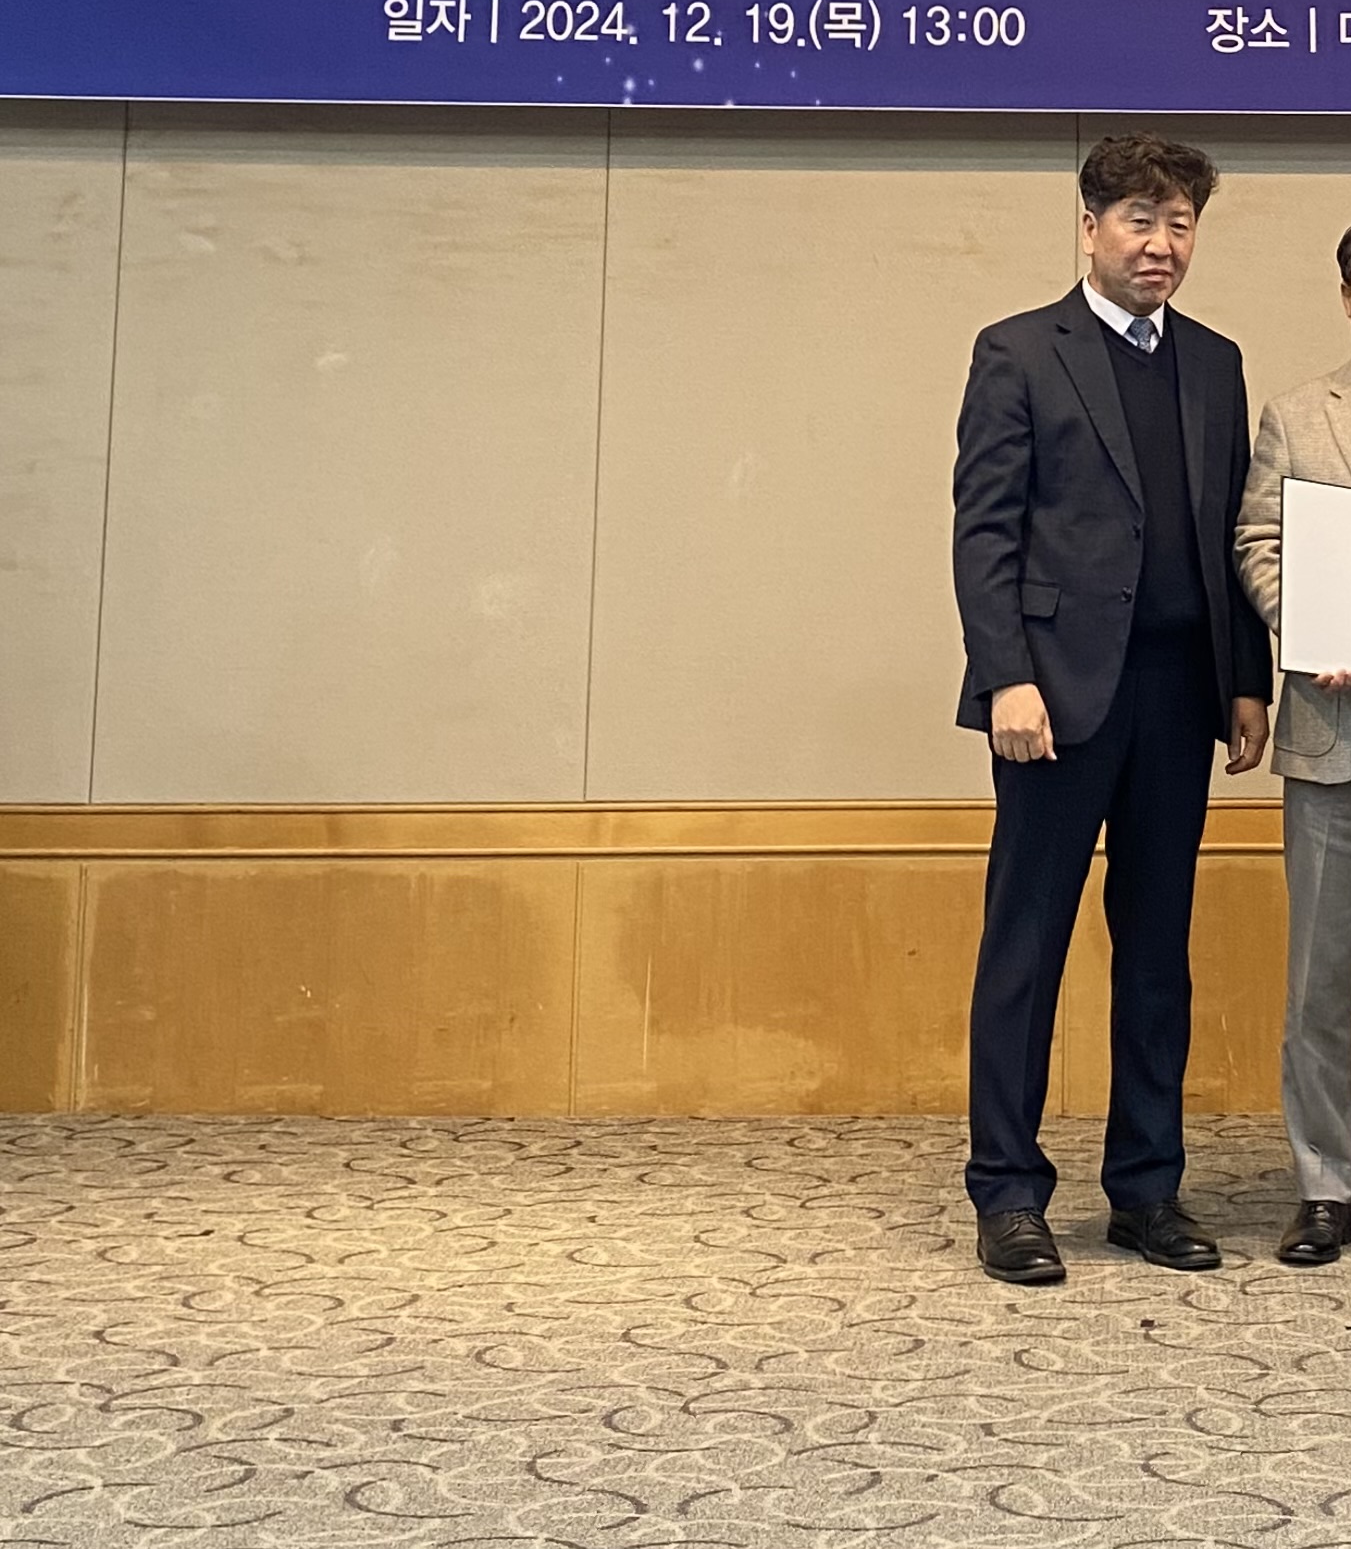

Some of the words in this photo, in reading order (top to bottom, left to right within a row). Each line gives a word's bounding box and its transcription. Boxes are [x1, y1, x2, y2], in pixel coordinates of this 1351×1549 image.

[519, 0, 639, 45] 2024.
[661, 1, 724, 47] 12.
[901, 5, 1026, 47] 13:00
[1205, 6, 1291, 53] 장소
